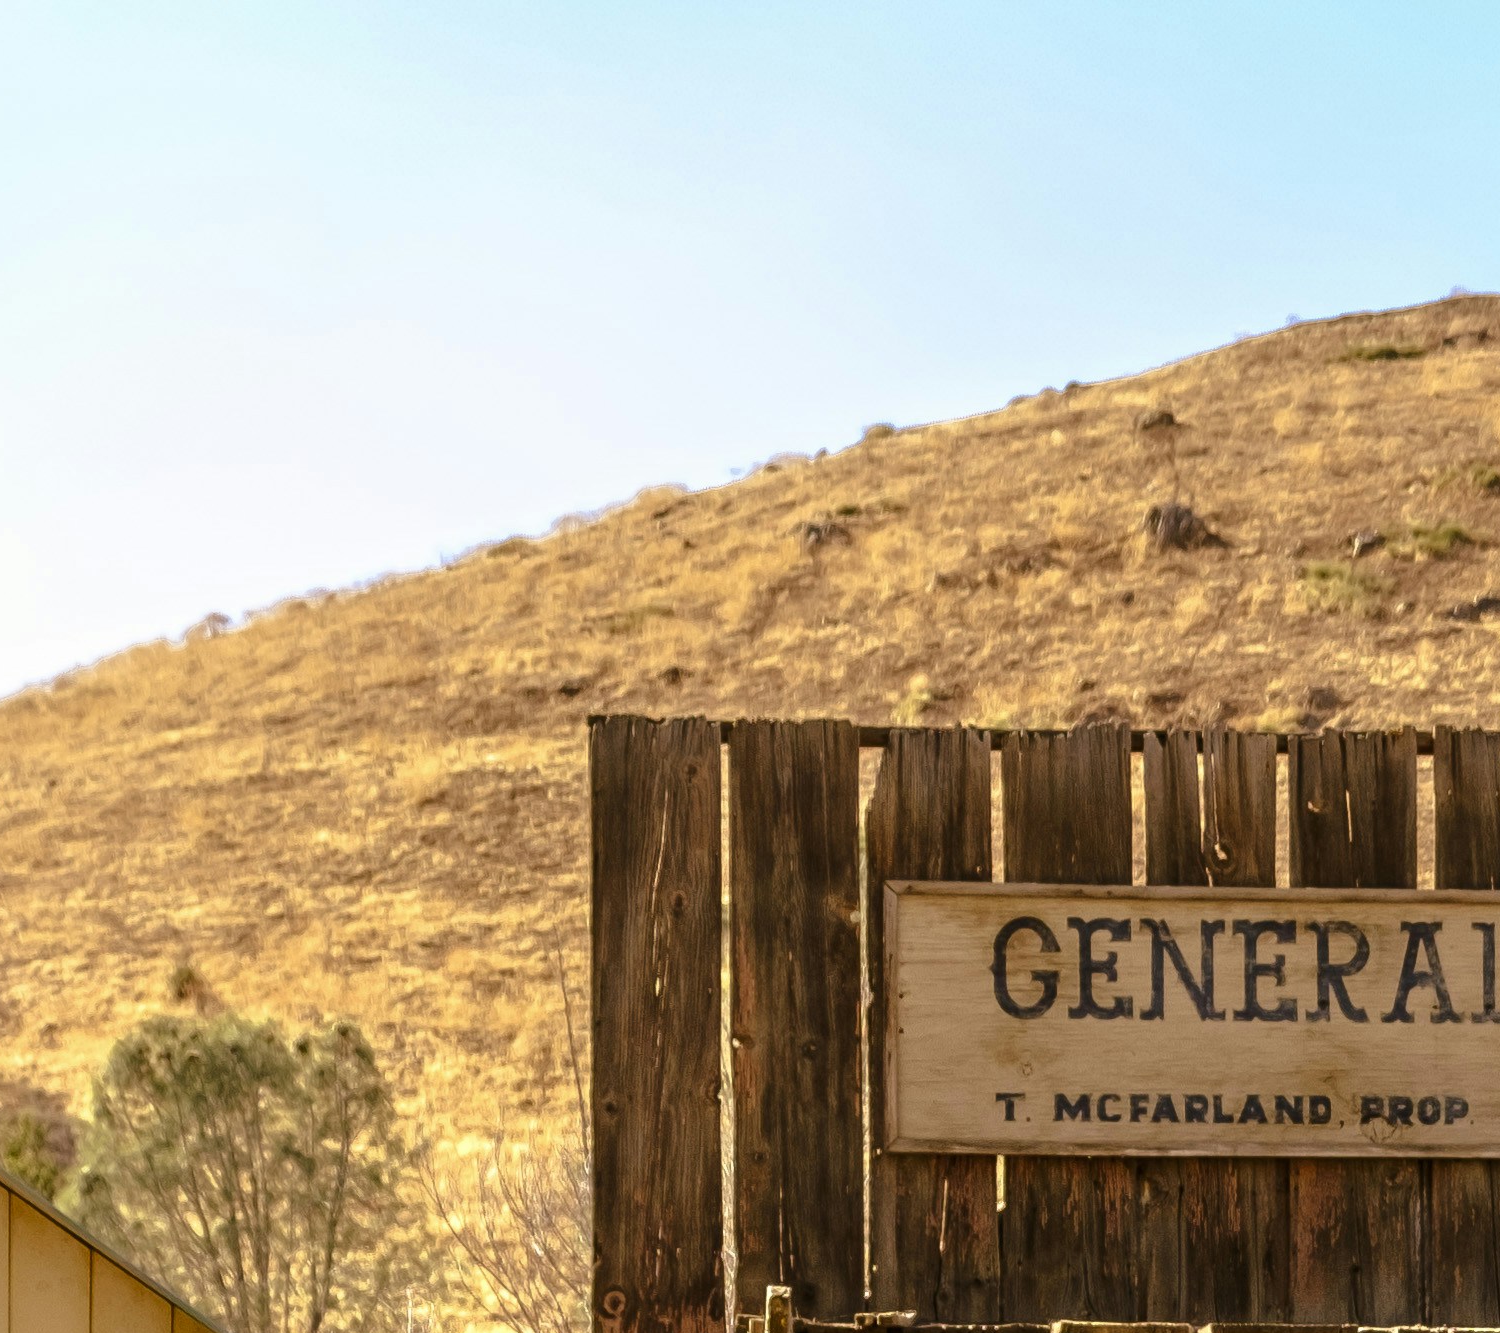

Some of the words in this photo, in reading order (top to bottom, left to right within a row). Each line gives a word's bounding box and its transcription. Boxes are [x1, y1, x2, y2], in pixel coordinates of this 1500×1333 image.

[995, 1092, 1031, 1122] T.
[1052, 1093, 1345, 1128] MCFARLAND,
[1358, 1094, 1475, 1126] PROP.
